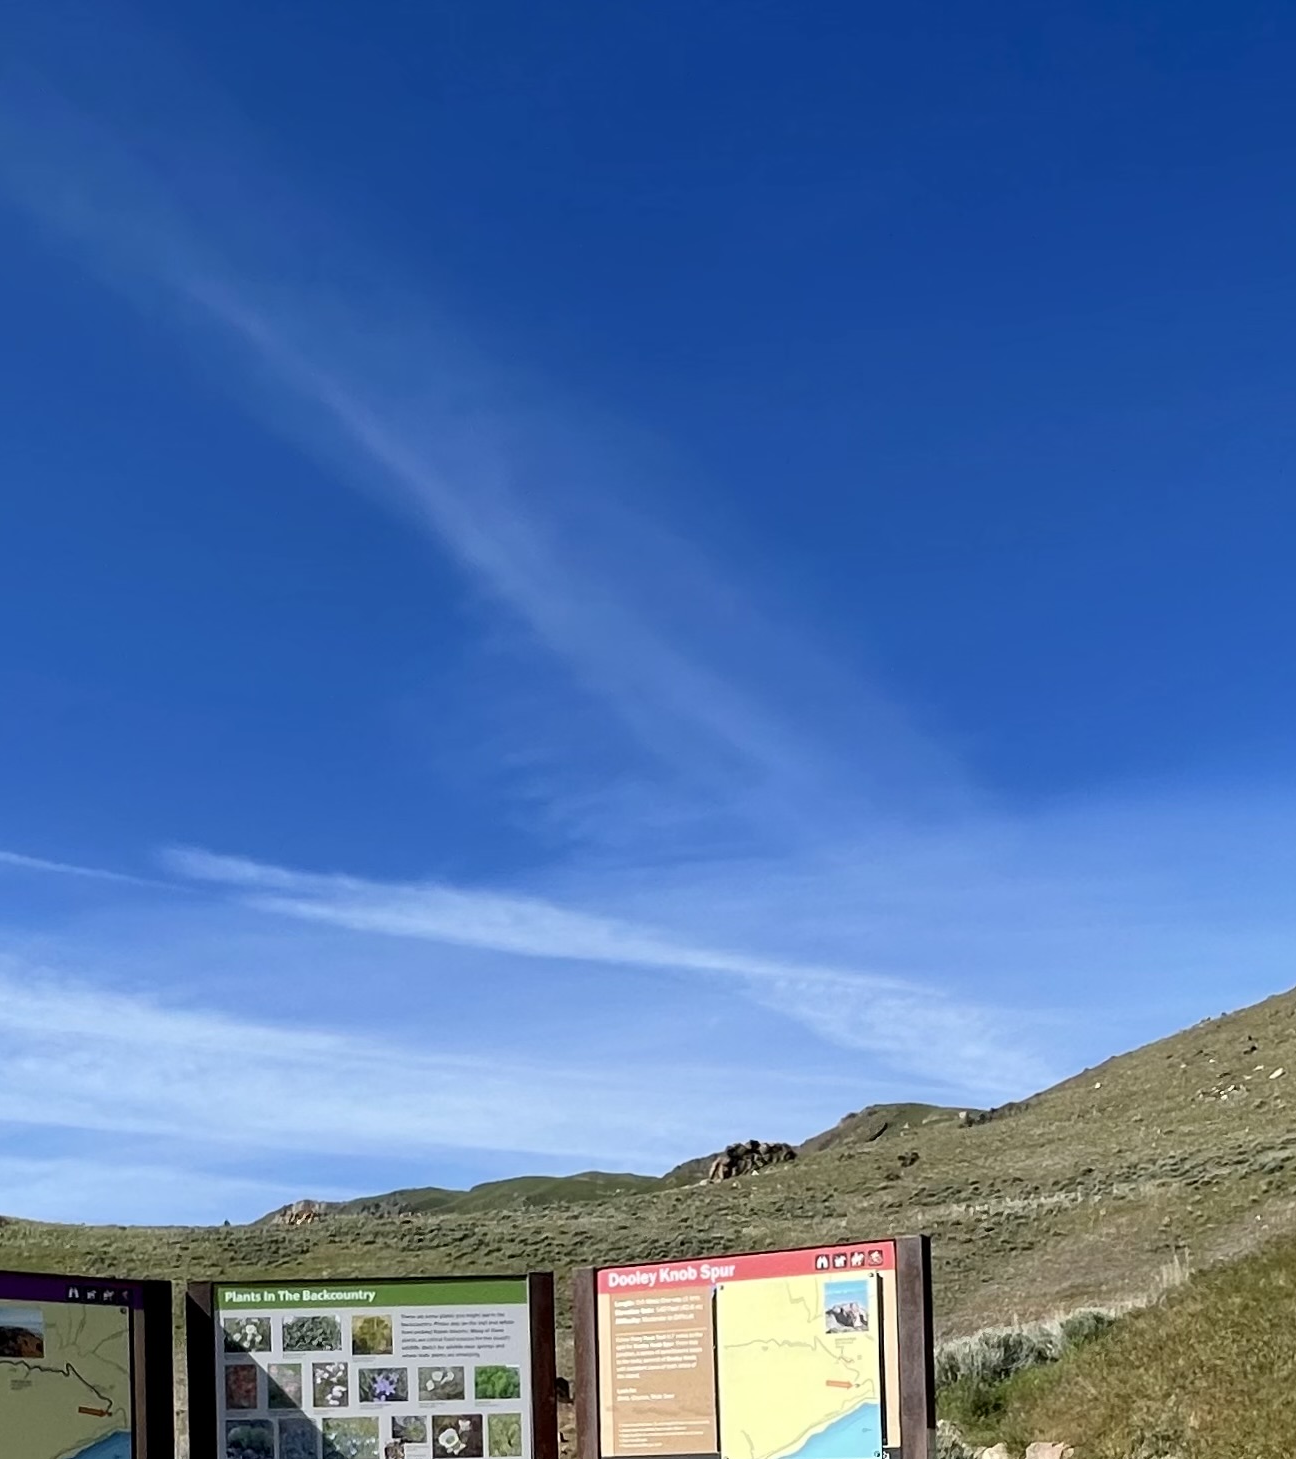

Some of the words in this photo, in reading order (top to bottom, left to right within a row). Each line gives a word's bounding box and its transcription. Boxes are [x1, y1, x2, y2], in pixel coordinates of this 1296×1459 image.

[608, 1271, 657, 1287] Dooley
[659, 1265, 697, 1282] Knob
[700, 1263, 735, 1283] Spur
[225, 1291, 261, 1303] Plants
[263, 1291, 276, 1302] In
[278, 1290, 300, 1302] The
[303, 1289, 376, 1302] Backcountry
